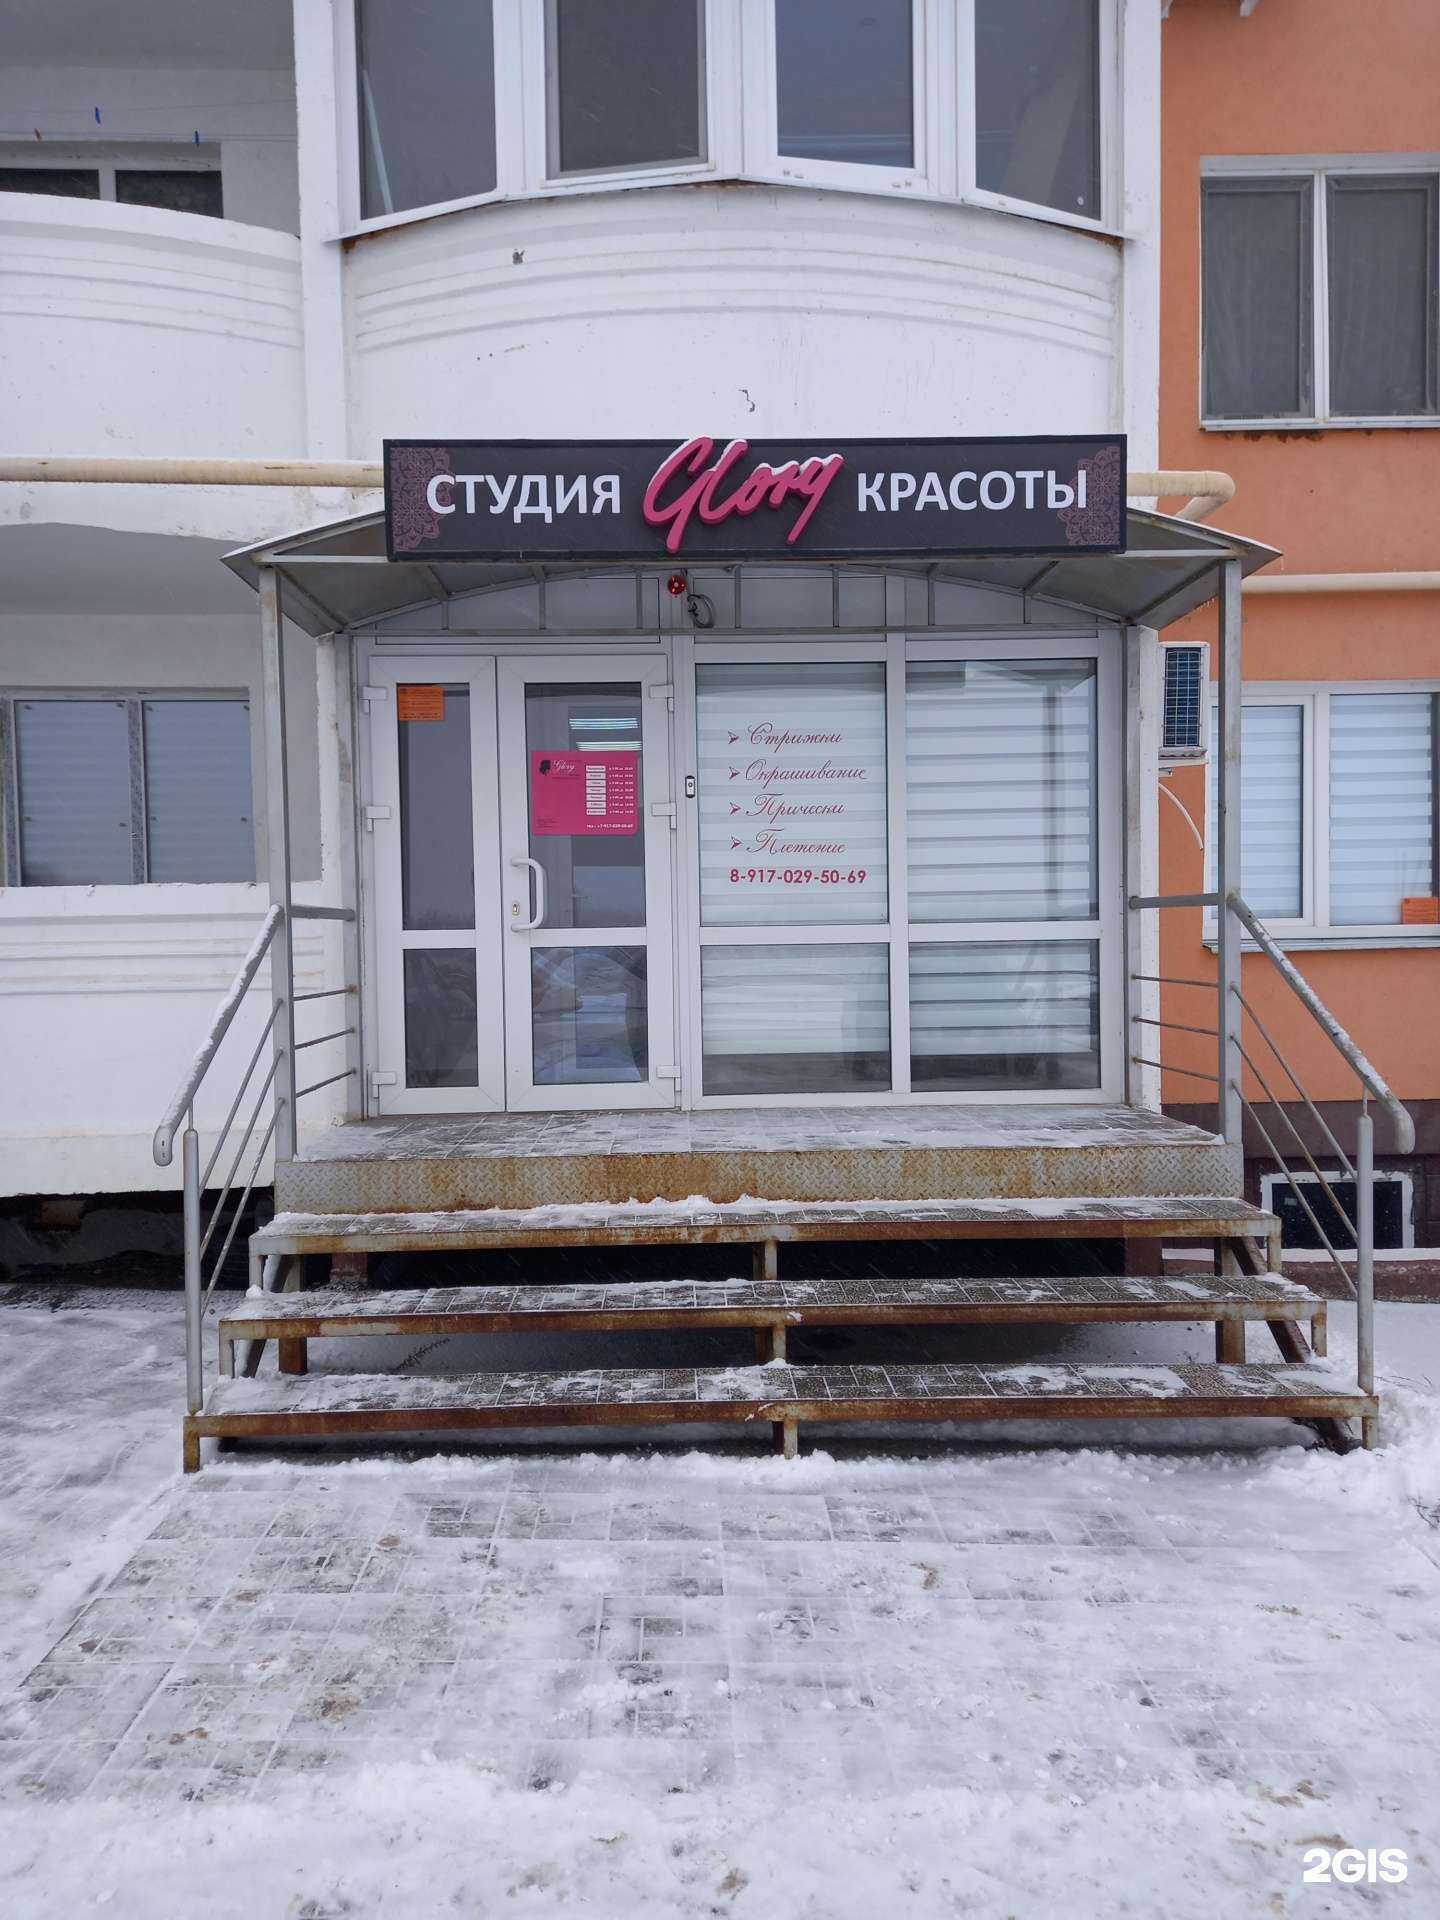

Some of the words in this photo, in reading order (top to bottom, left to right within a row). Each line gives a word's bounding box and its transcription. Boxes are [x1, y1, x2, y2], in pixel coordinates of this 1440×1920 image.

[425, 473, 621, 523] СТУДИЯ
[643, 435, 845, 553] Glory
[858, 470, 1087, 513] КРАСОТЫ
[748, 722, 843, 753] Стрижки
[745, 759, 868, 789] Окрашивание
[746, 793, 844, 824] Прически
[746, 828, 847, 855] Плетение
[730, 869, 866, 883] 8-917-029-50-69
